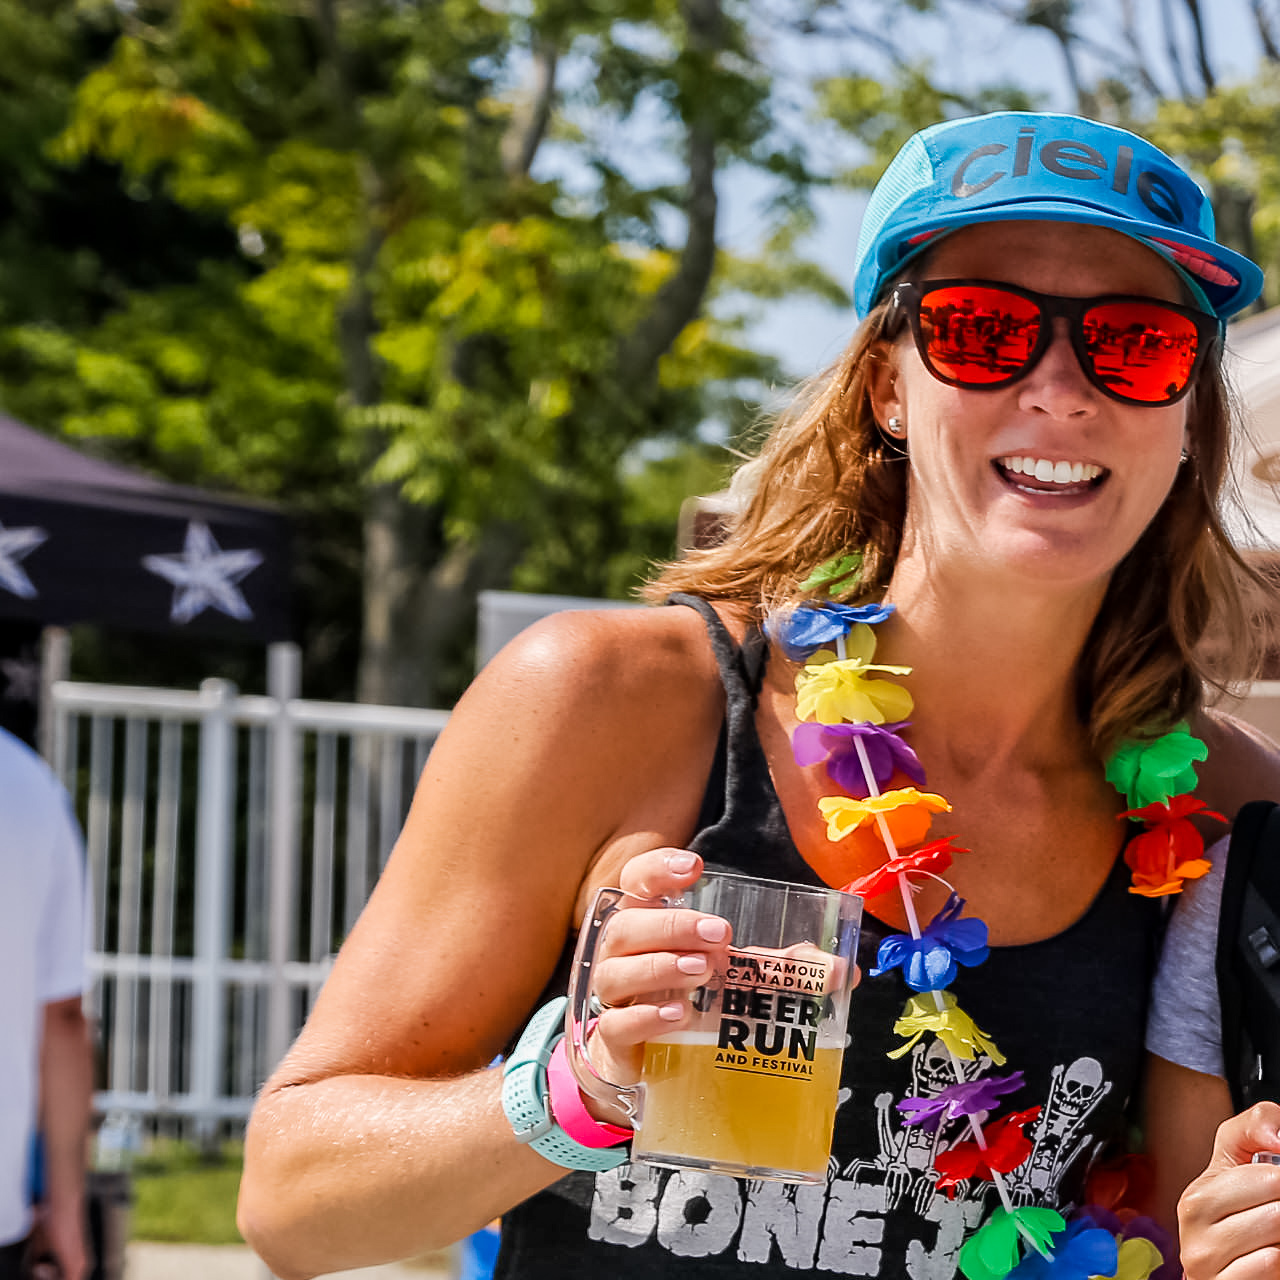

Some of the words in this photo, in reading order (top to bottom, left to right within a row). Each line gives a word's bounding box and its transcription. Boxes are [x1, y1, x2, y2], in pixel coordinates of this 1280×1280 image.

[726, 967, 825, 993] CANADIAN
[728, 955, 759, 969] THE
[763, 960, 825, 979] FAMOUS
[721, 988, 823, 1028] BEER
[717, 1018, 819, 1062] RUN
[714, 1051, 748, 1066] AND
[752, 1057, 814, 1075] FESTIVAL
[587, 1162, 886, 1278] BONE
